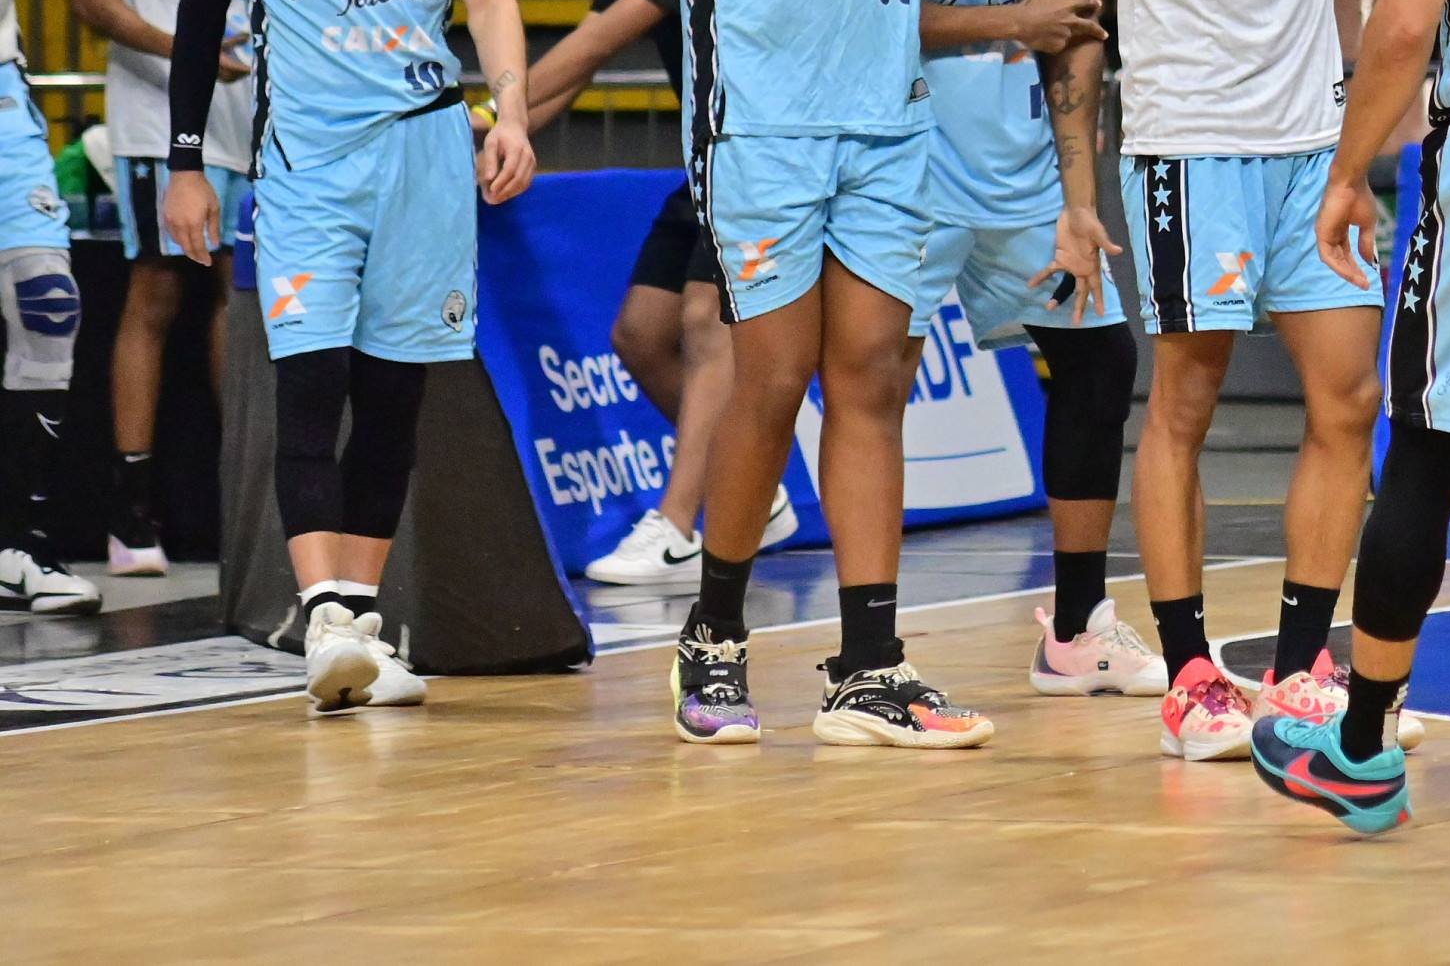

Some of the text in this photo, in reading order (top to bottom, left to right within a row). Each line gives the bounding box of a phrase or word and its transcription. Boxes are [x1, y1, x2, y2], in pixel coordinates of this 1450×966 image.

[321, 25, 434, 52] CAIXA
[907, 304, 973, 405] DF
[534, 429, 664, 516] Esporte
